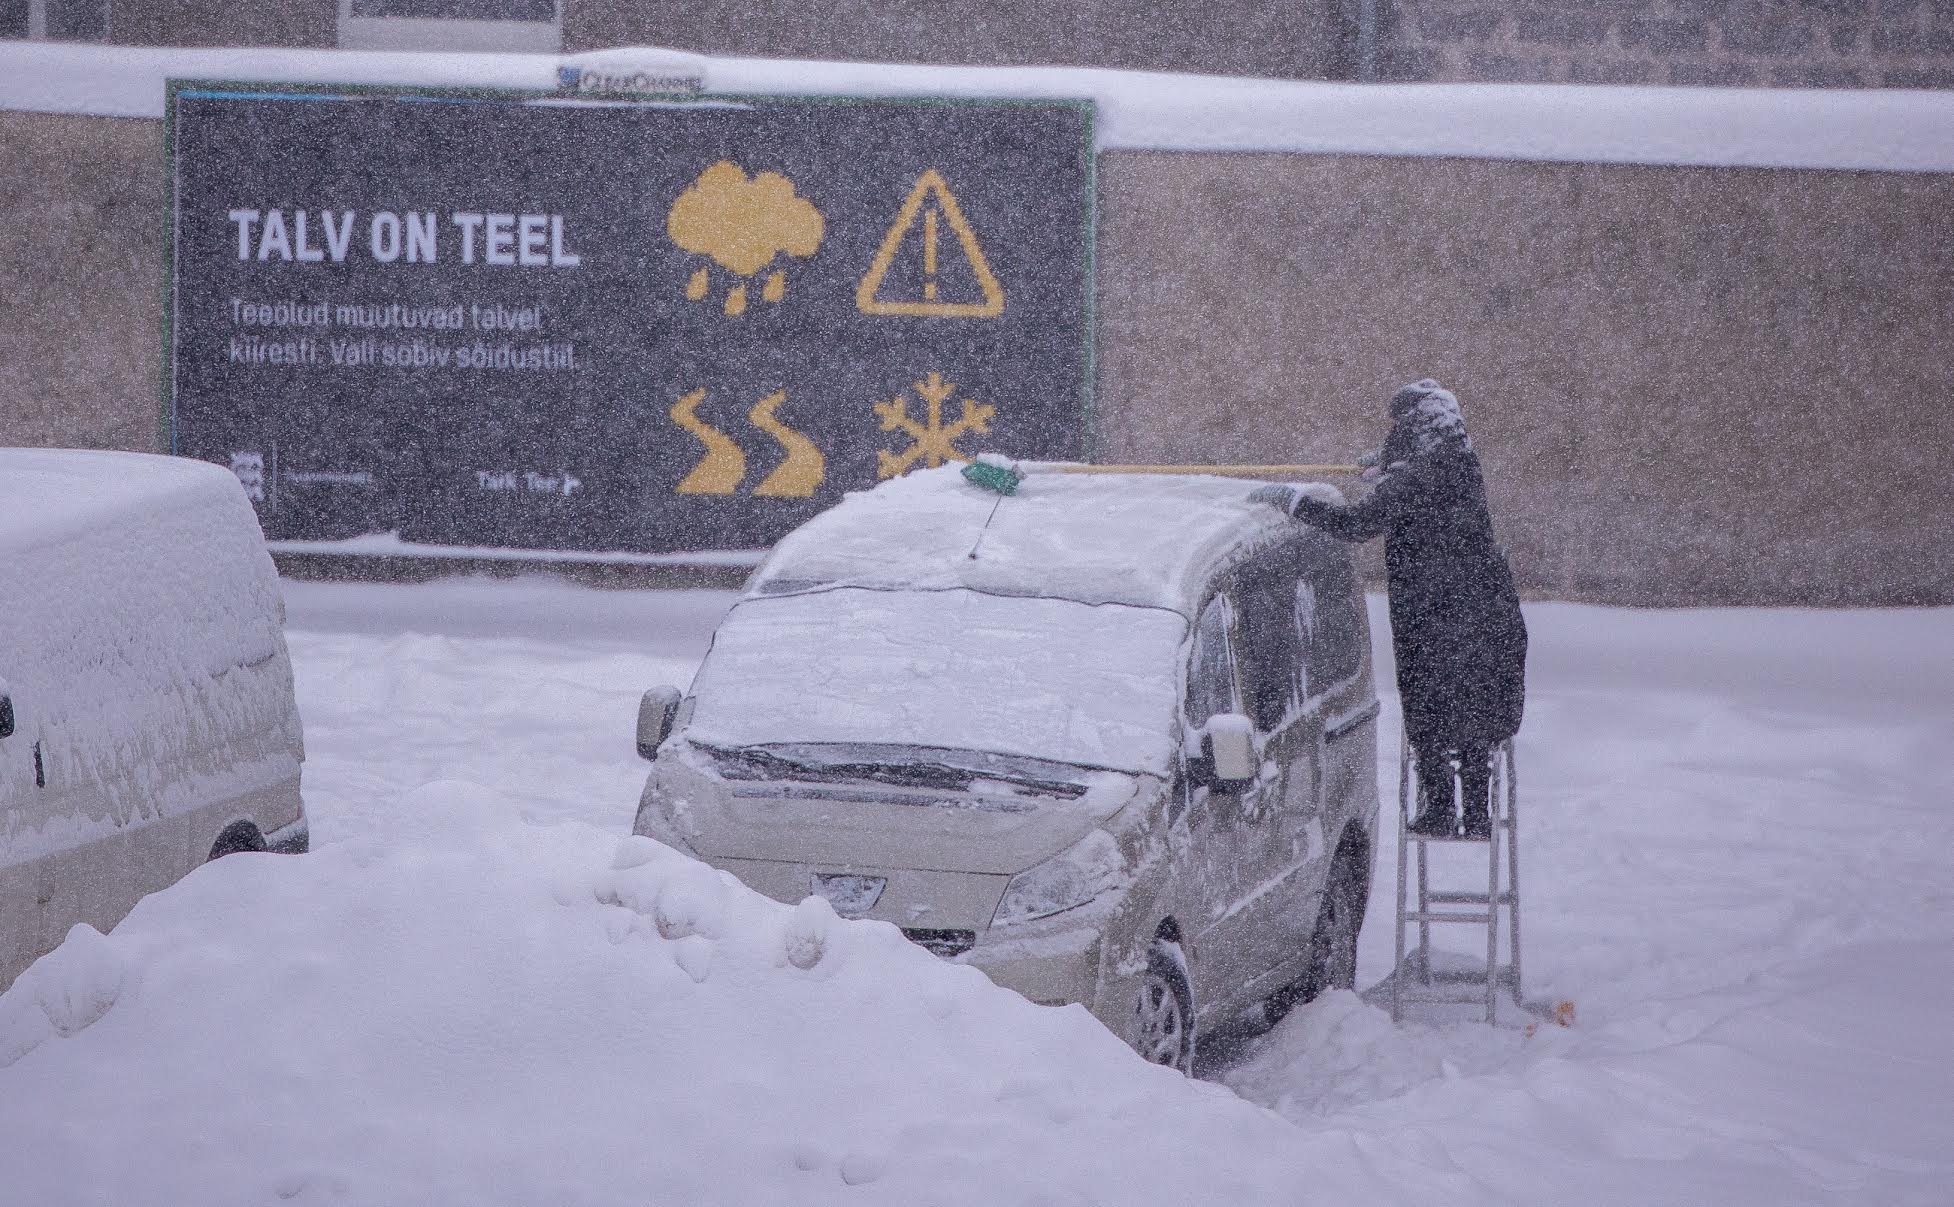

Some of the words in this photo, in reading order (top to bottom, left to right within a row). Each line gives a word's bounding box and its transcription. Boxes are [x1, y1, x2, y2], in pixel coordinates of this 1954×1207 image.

[229, 209, 356, 263] TALV
[371, 211, 438, 265] ON
[454, 213, 581, 267] TEEL
[229, 298, 329, 327] Teeolud
[336, 303, 464, 329] muutuvad
[471, 304, 542, 331] talvel
[330, 337, 377, 366] Vali
[382, 338, 451, 367] sobiv
